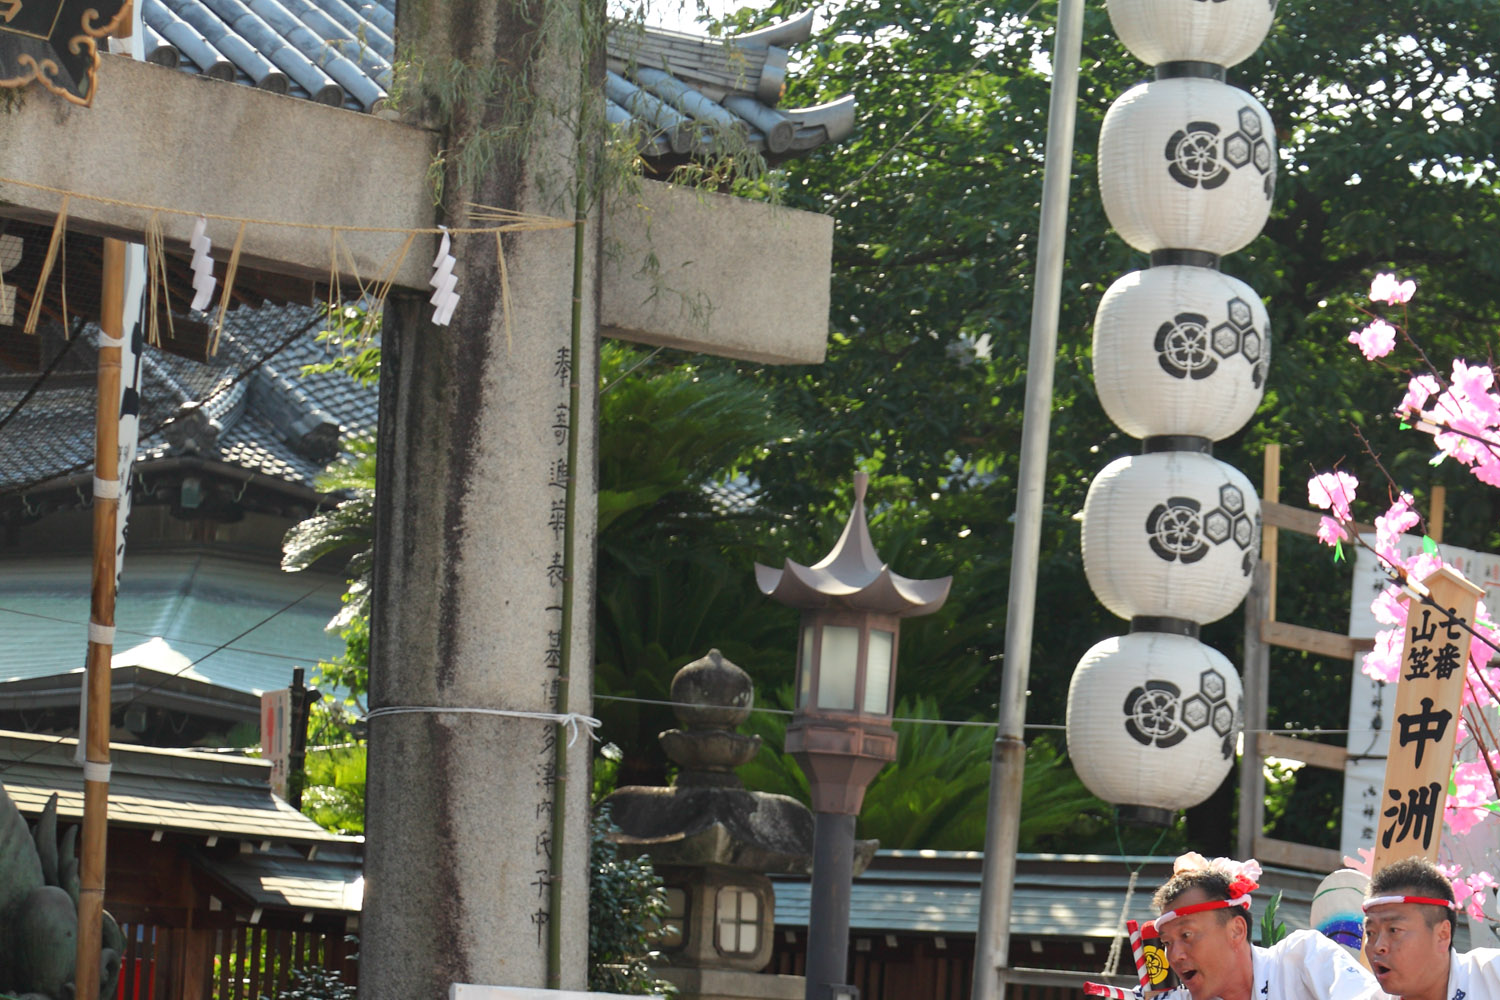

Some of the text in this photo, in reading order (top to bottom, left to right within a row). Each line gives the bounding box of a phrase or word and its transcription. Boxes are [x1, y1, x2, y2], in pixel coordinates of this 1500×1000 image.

[1405, 609, 1436, 682] 山笠
[1430, 607, 1465, 680] 七番
[1382, 697, 1453, 850] 中洲
